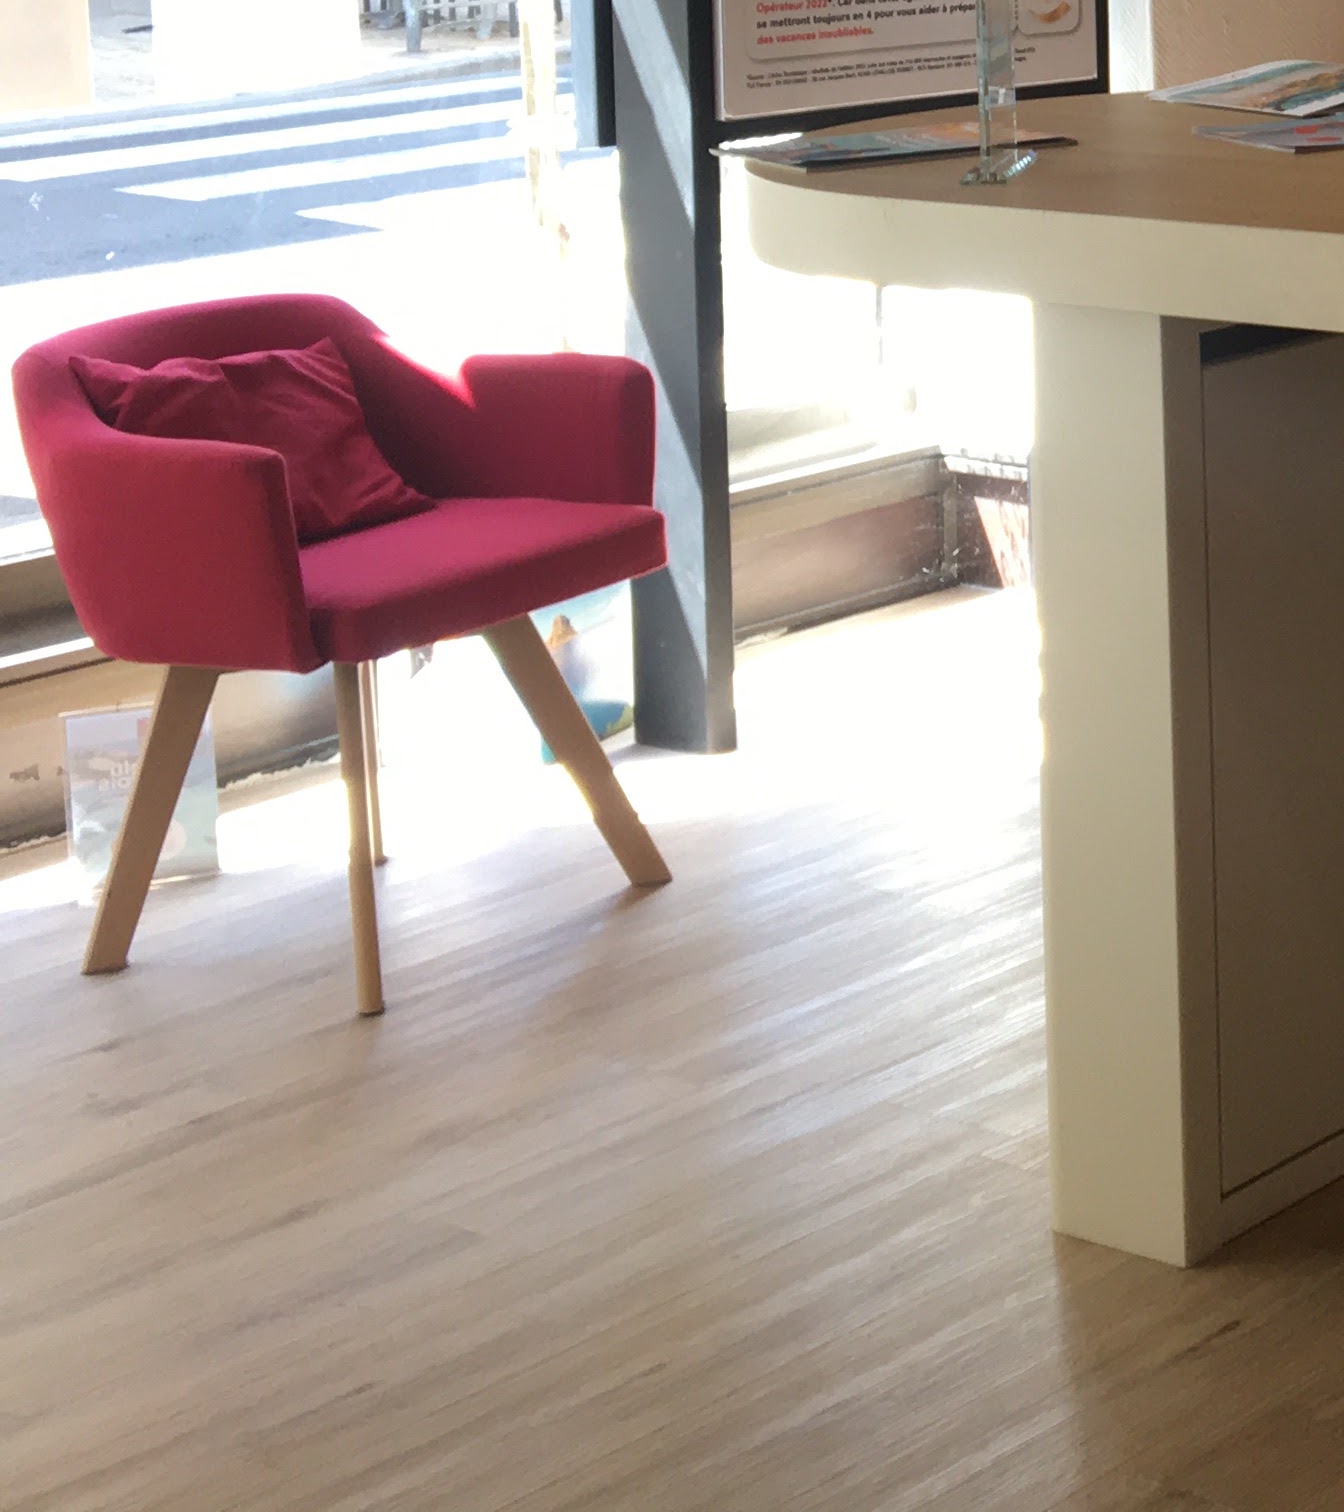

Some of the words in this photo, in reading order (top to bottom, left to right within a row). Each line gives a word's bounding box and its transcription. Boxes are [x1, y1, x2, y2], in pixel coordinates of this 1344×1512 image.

[756, 1, 804, 15] Opérateur
[756, 20, 767, 29] se
[770, 16, 811, 29] mettront
[813, 13, 850, 27] toujours
[853, 11, 864, 21] en
[874, 8, 894, 21] pour
[897, 7, 916, 18] vous
[919, 4, 940, 15] aider
[757, 34, 774, 45] des
[776, 31, 816, 43] vacances
